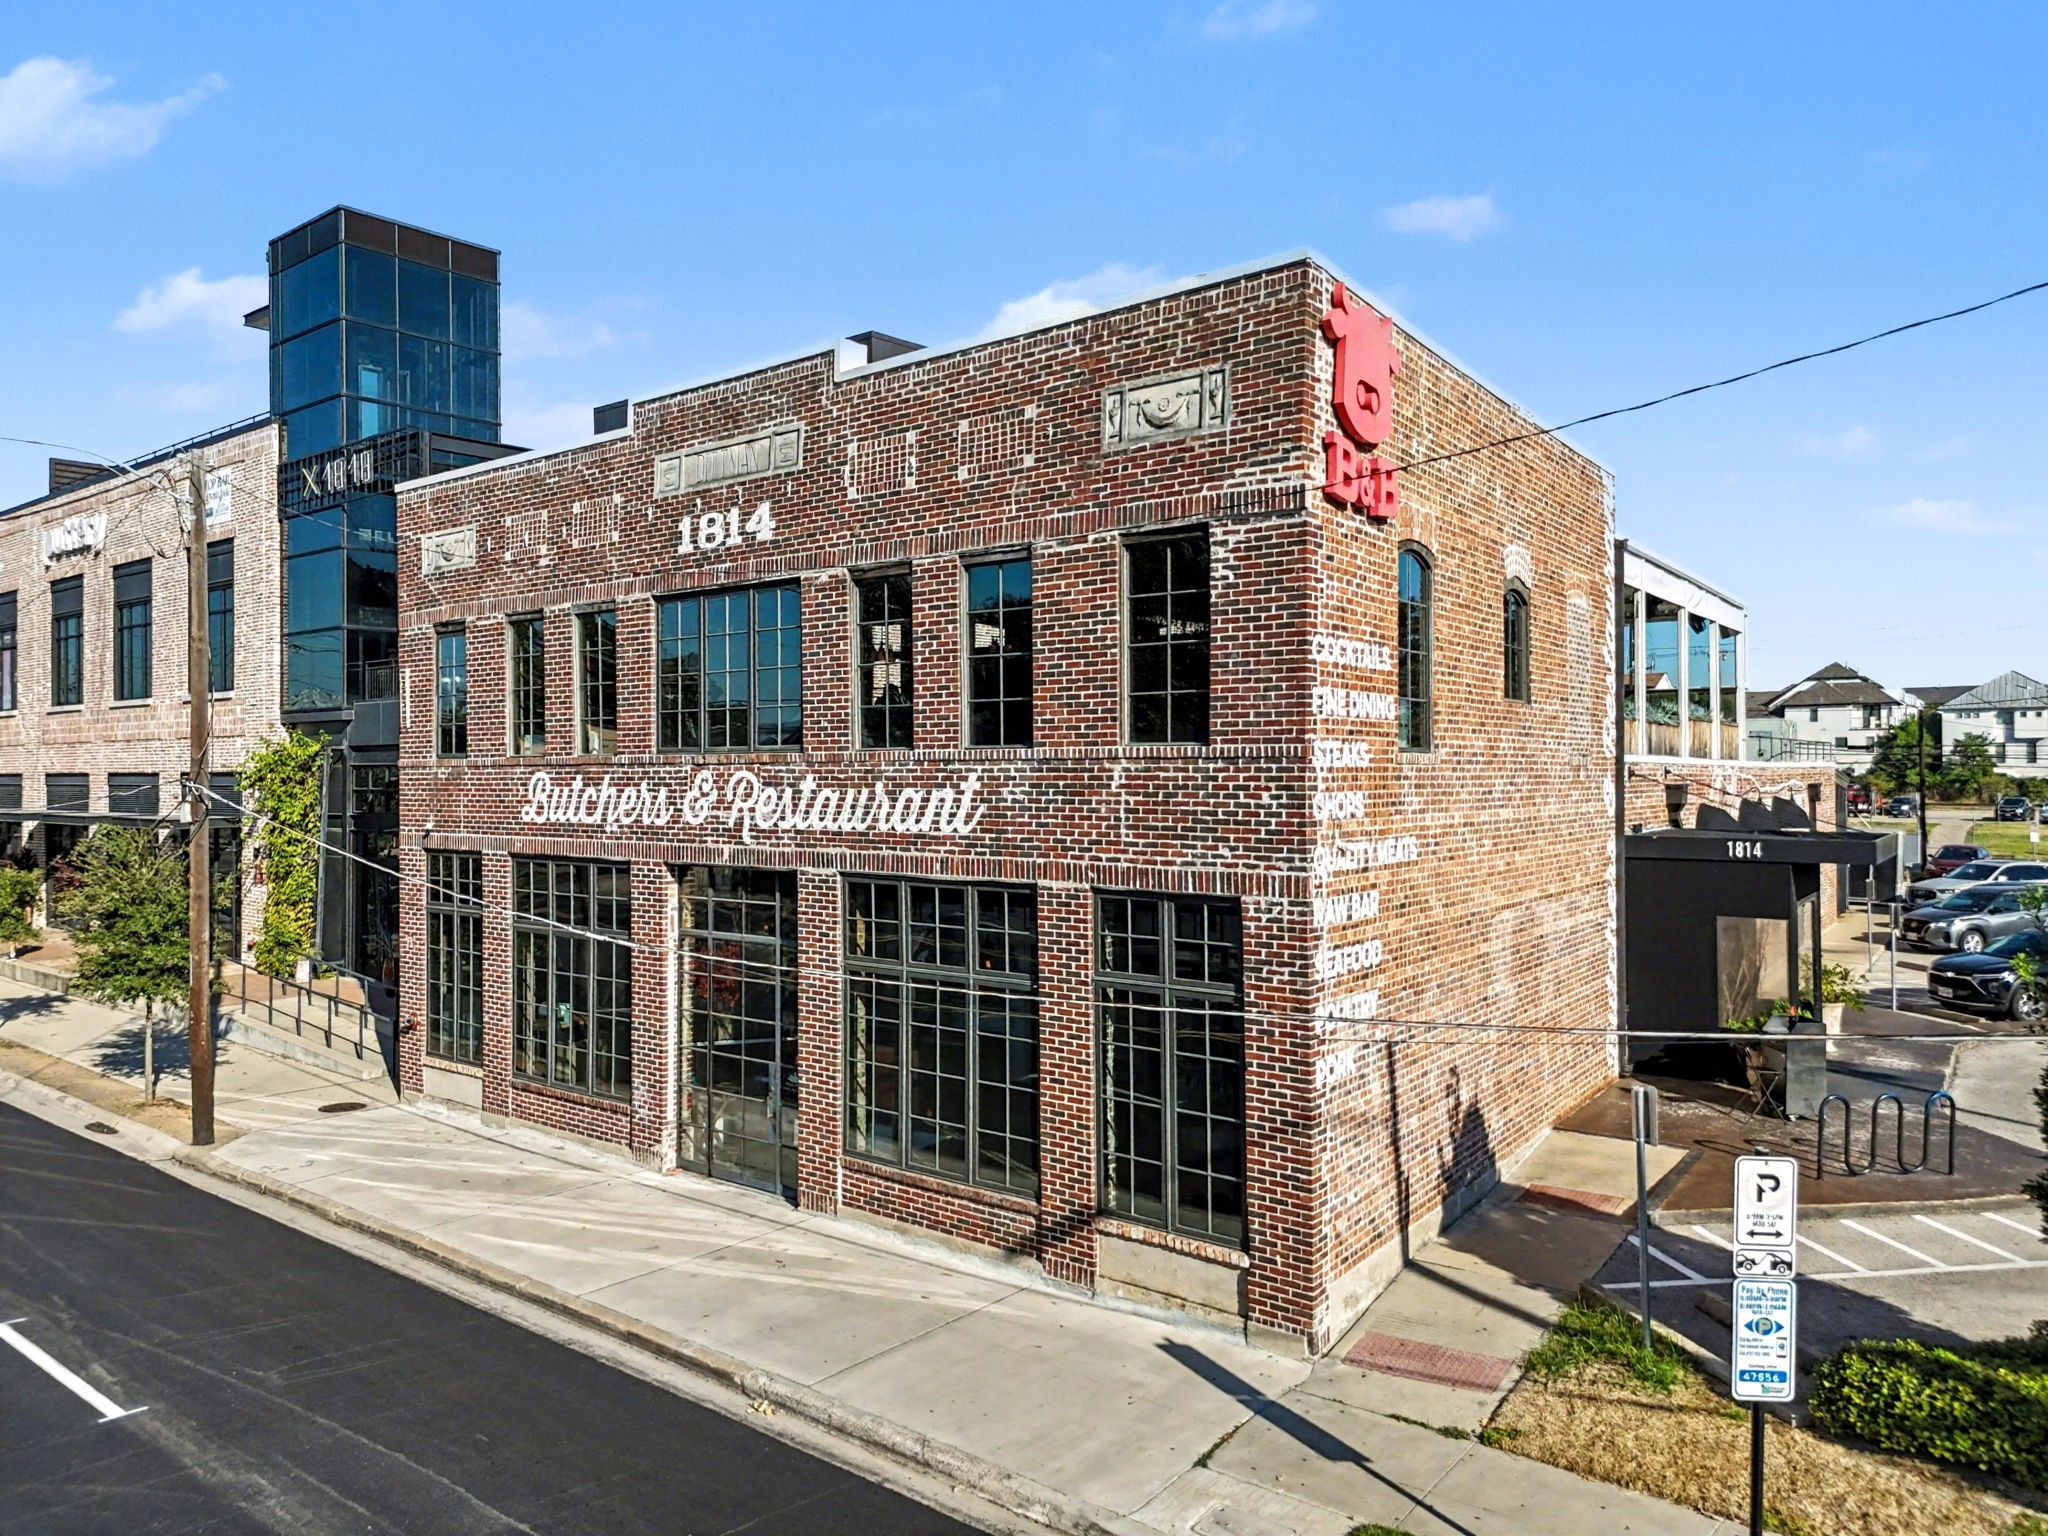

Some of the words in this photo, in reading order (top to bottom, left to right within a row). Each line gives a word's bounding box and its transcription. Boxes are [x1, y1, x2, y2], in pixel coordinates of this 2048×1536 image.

[677, 500, 776, 555] 1814
[1311, 634, 1392, 671] COCKTAILS
[1312, 686, 1346, 717] FINE
[1349, 690, 1396, 721] DINING
[1312, 739, 1371, 768] STEAKS
[521, 771, 673, 826] Butchers
[683, 769, 718, 826] &
[726, 770, 985, 845] Restaurant
[1377, 836, 1418, 866] MEATS
[1726, 840, 1763, 859] 1814
[1313, 896, 1350, 927] RAW
[1351, 890, 1380, 920] BAR
[1313, 939, 1382, 981] SEAFOOD
[1314, 989, 1379, 1036] POULTRY
[1315, 1050, 1356, 1090] PORK
